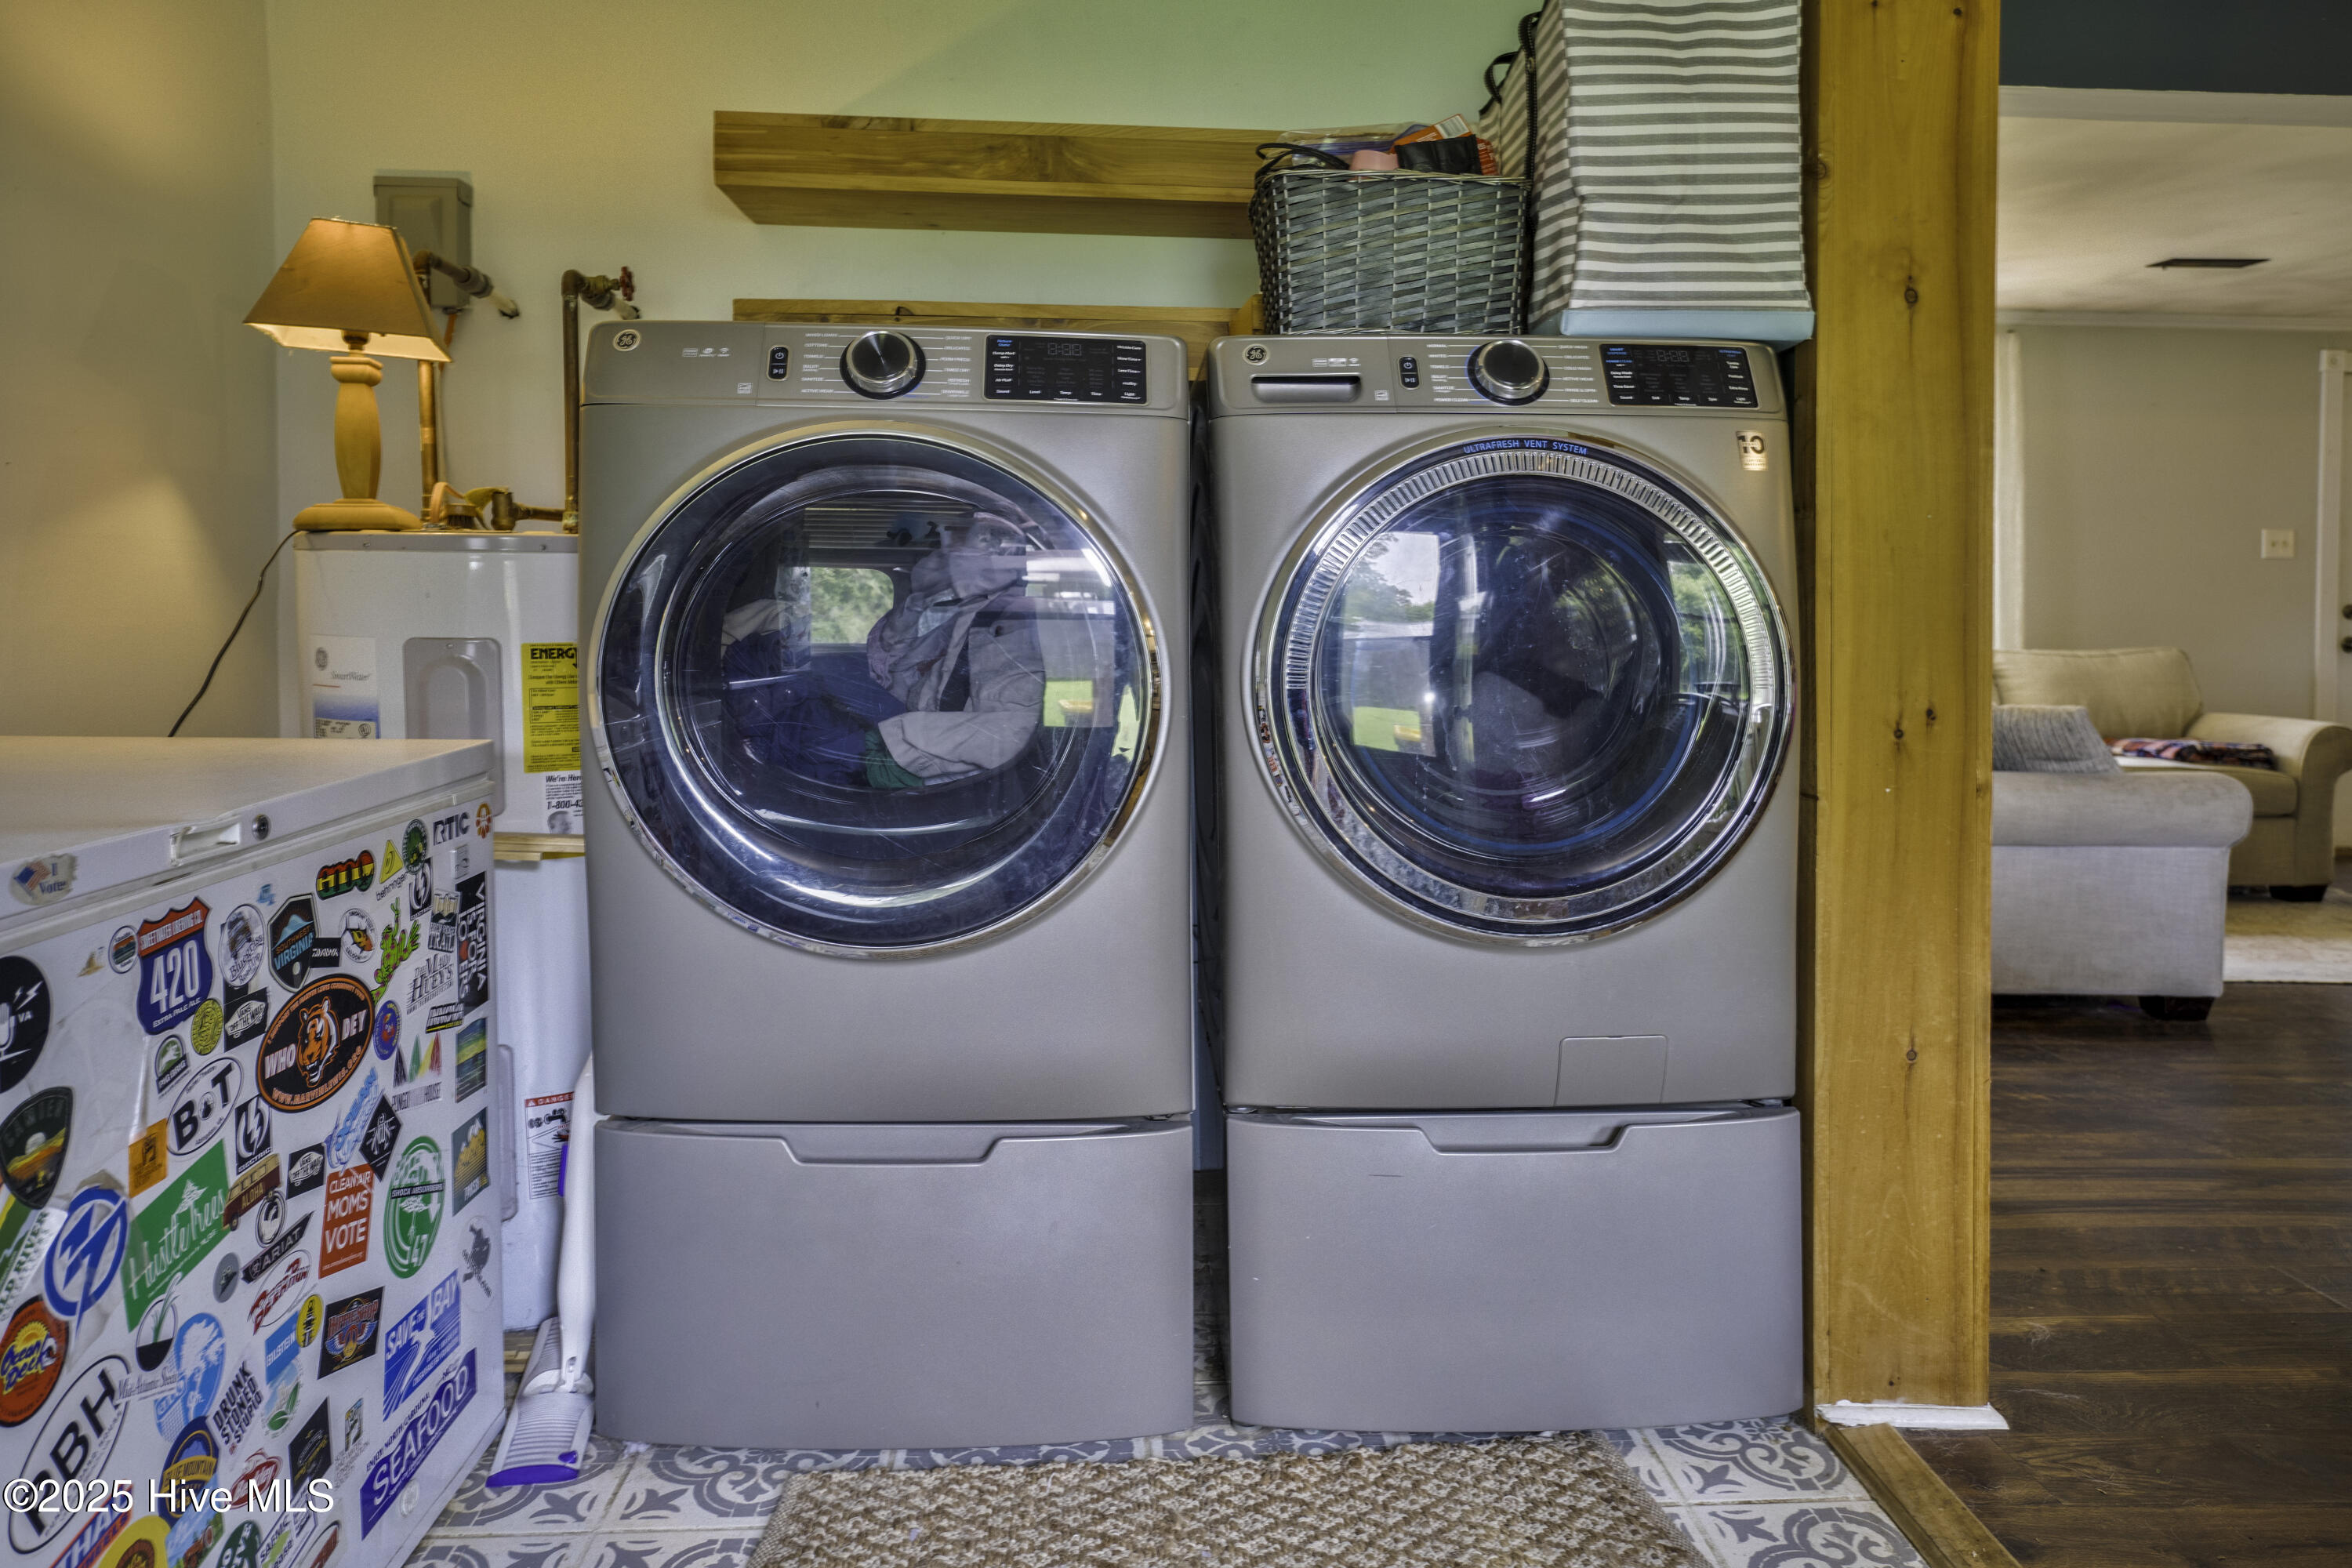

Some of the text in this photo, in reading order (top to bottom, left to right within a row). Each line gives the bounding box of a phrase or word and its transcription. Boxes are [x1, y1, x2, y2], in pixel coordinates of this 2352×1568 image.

[1464, 440, 1587, 455] ULTRAFRESH VENT SYSTEM
[433, 811, 470, 846] RTIC
[52, 862, 58, 877] I
[376, 871, 408, 902] behringer
[39, 880, 67, 895] Vote
[274, 934, 314, 971] VIRGINIA
[276, 927, 310, 954] SOUTHWEST
[476, 881, 487, 992] VIRGINIA
[151, 939, 200, 1014] 420
[17, 1011, 33, 1023] VA
[153, 997, 201, 1028] EXTRA PALE ALE
[264, 1044, 296, 1080] WHO
[341, 1009, 368, 1041] DEY
[173, 1100, 198, 1151] B
[211, 1062, 233, 1109] T
[238, 1146, 272, 1173] ELECTRIC
[241, 1183, 264, 1210] ALOHA
[329, 1171, 371, 1194] CLEAN AIR
[392, 1183, 443, 1198] SHOCK ABSORBERS
[326, 1190, 369, 1222] MOMS
[260, 1226, 303, 1272] ARIAT
[325, 1218, 367, 1254] VOTE
[386, 1310, 419, 1361] SAVE
[432, 1276, 459, 1322] BAY
[212, 1361, 252, 1432] DRUNK
[220, 1376, 258, 1446] STONED
[234, 1390, 263, 1444] STUPID
[366, 1392, 431, 1472] ENJOY NORTH CAROLINA
[373, 1365, 469, 1507] SEAFOOD
[182, 1457, 213, 1477] MOUNTAIN
